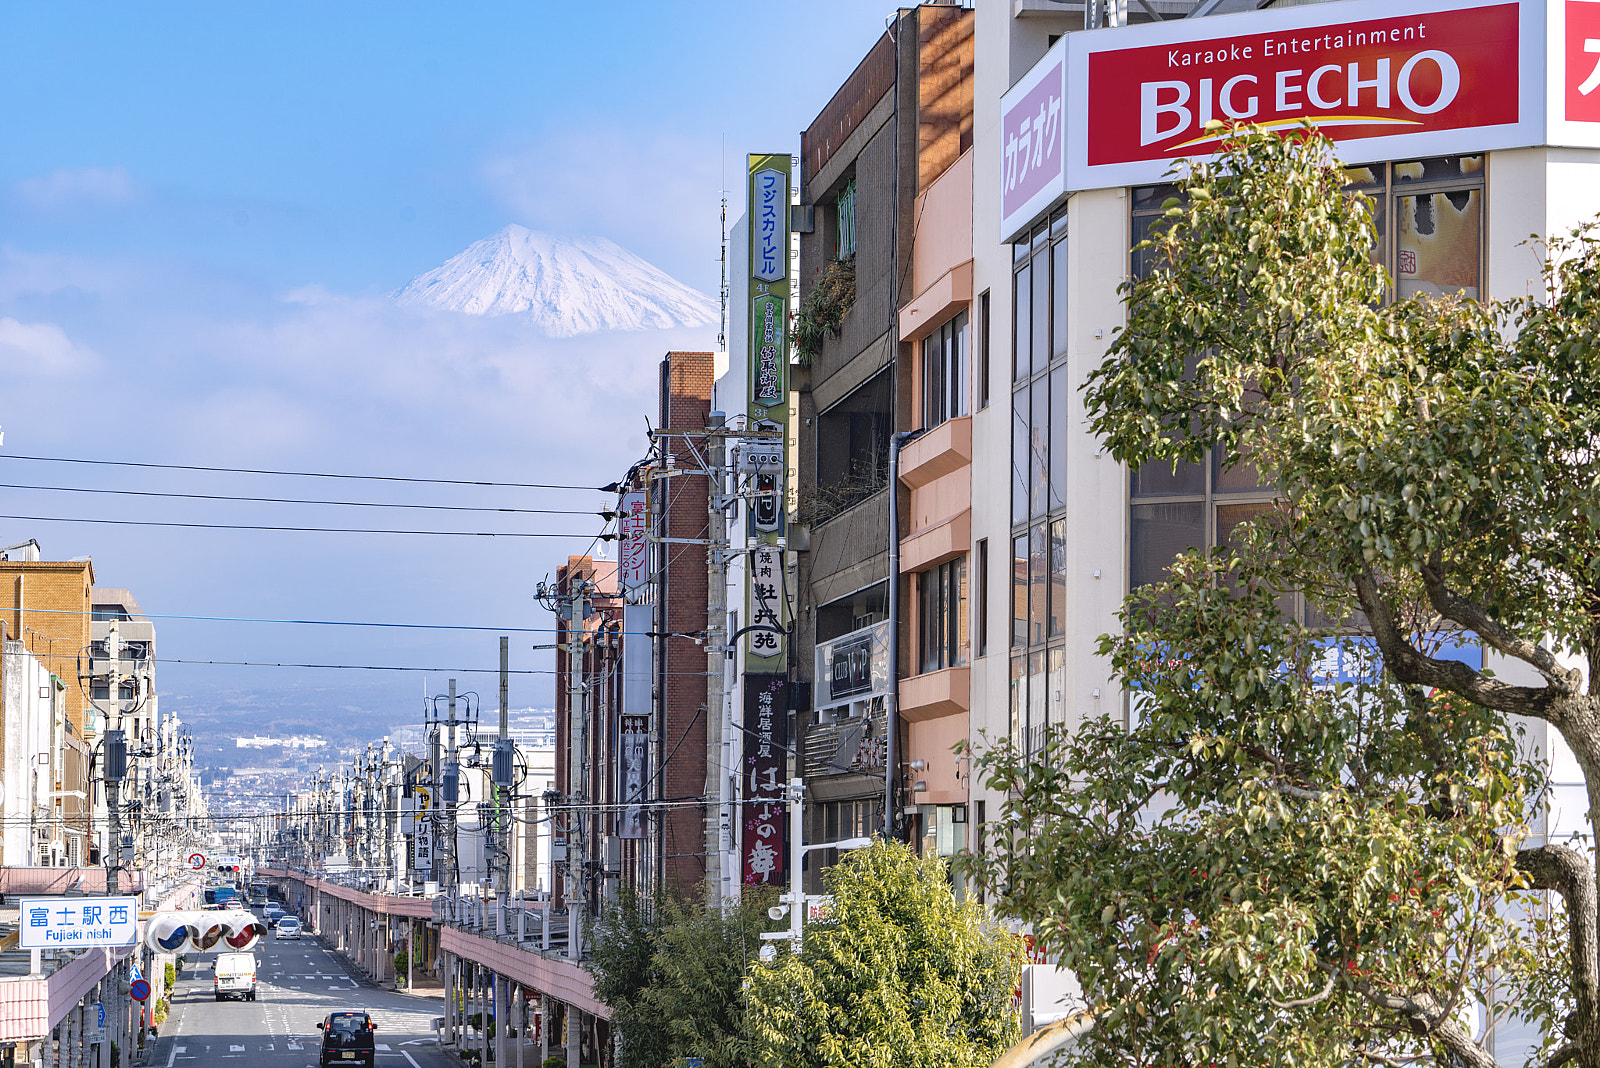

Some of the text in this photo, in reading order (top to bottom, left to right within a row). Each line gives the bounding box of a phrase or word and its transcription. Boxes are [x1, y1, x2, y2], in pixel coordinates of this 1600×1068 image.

[1167, 22, 1427, 68] Karaoke Entertainment
[1140, 49, 1461, 148] BIG ECHO
[1004, 94, 1061, 197] カラオケ
[761, 176, 777, 275] フジスカイビル
[755, 283, 770, 293] 4F
[759, 345, 778, 398] 竹取御殿
[754, 408, 769, 418] 3F
[631, 500, 645, 581] 富士タクシー
[759, 551, 773, 579] 焼肉
[757, 690, 774, 759] 海鮮居酒屋
[747, 766, 779, 883] はなの舞
[29, 905, 129, 928] 富士駅西
[45, 928, 112, 943] Fujieki nishi
